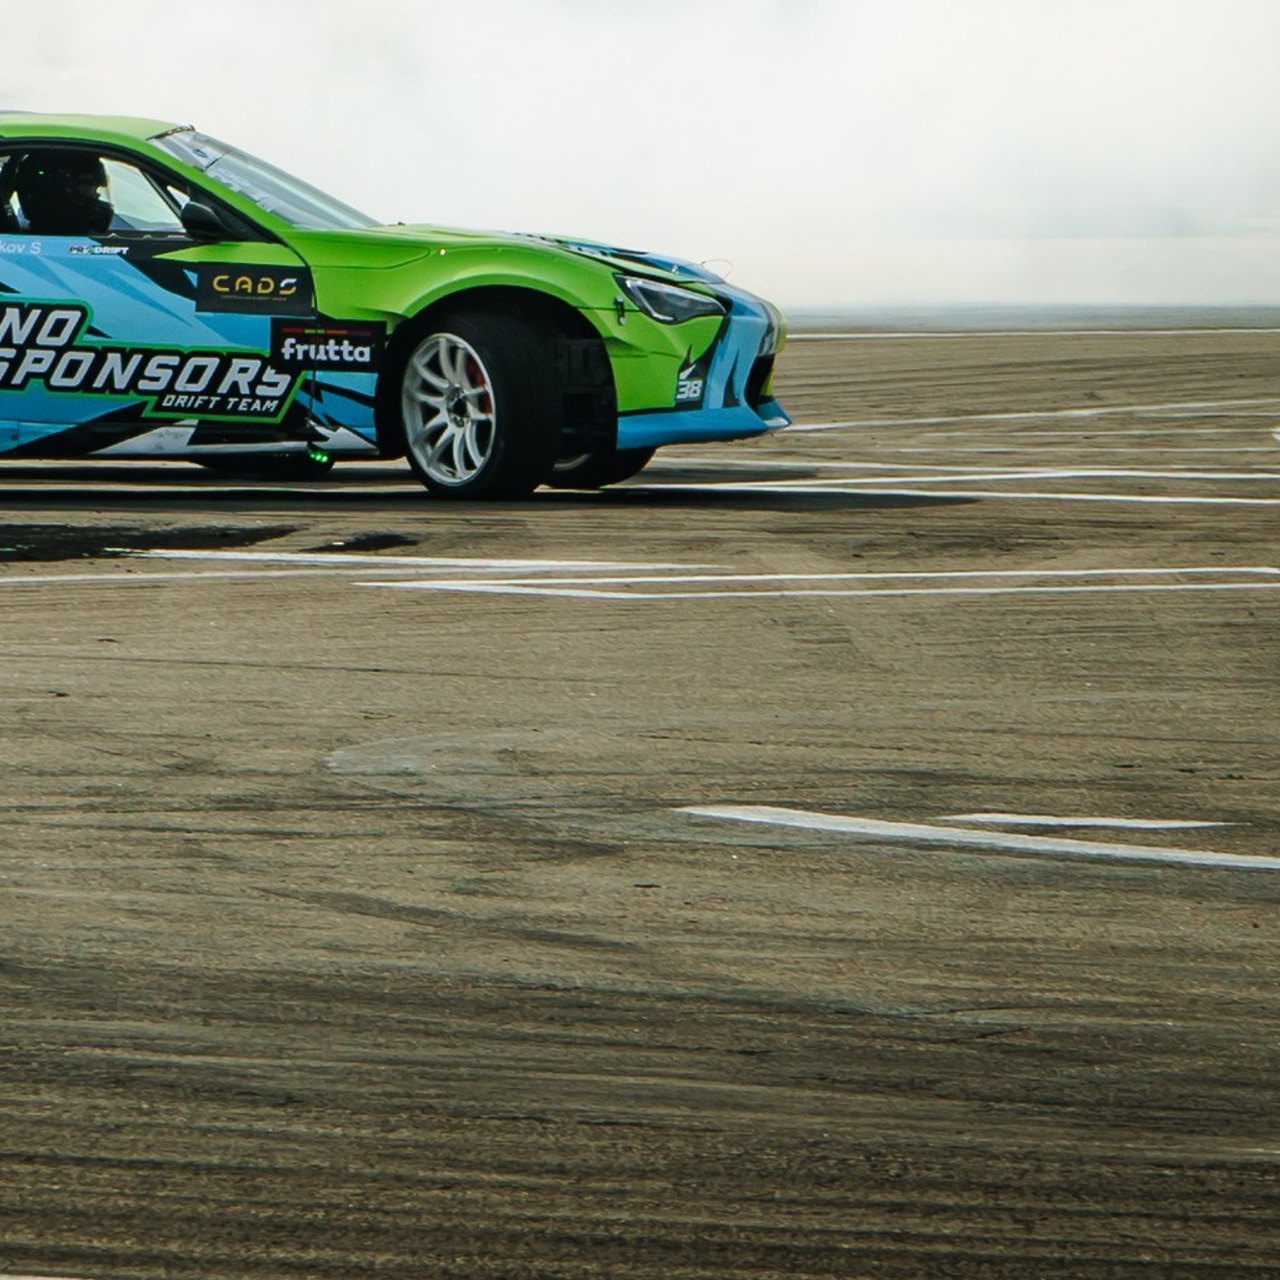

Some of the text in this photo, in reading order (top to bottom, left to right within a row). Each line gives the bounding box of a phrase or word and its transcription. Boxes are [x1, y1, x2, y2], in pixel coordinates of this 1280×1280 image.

[29, 241, 41, 254] S
[212, 275, 297, 295] CADS
[281, 337, 371, 362] frutta
[676, 380, 702, 399] 38
[162, 394, 279, 412] DRIFT TEAM
